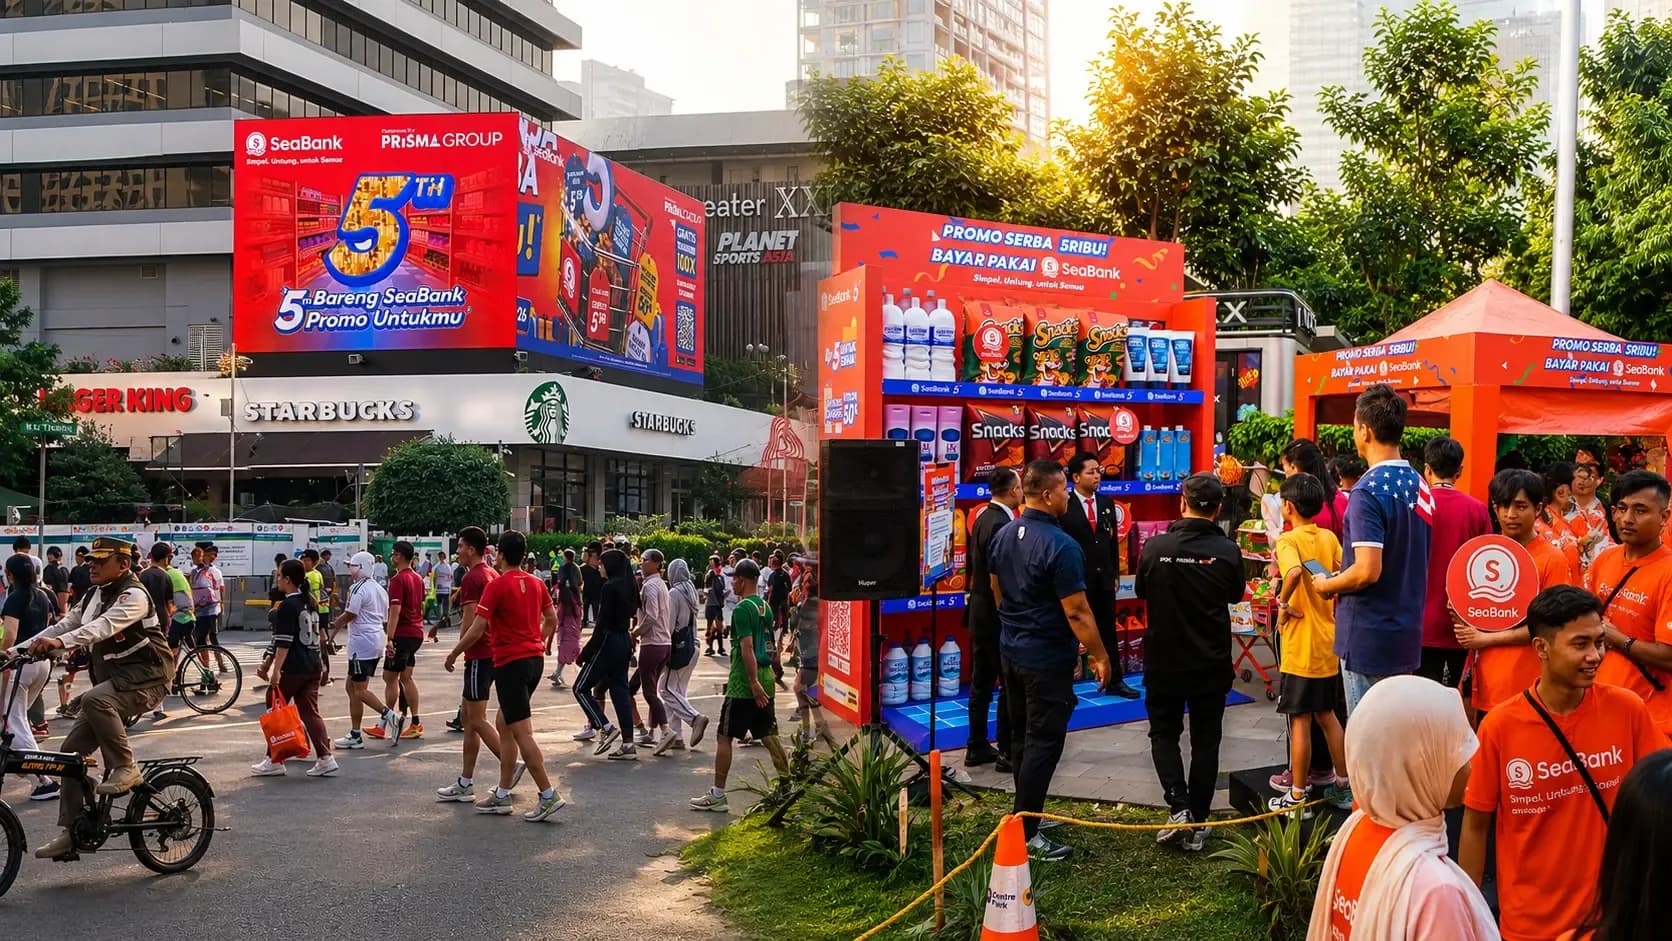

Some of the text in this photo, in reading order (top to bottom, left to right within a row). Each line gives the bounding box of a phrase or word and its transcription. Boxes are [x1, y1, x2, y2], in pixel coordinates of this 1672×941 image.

[270, 135, 343, 152] SeaBank
[442, 131, 503, 147] GROUP
[716, 229, 800, 252] PLANET
[942, 223, 1108, 256] PROMO SERBA 5RIBU!
[712, 251, 761, 265] SPORTS
[931, 247, 985, 268] BAYAR
[987, 254, 1037, 273] PAKAI
[1061, 262, 1121, 281] SeaBank
[314, 286, 464, 309] Bareng SeaBank
[305, 306, 463, 329] Promo Untukmu
[1034, 318, 1080, 347] Snacks
[1088, 323, 1129, 351] Snacks
[1552, 338, 1590, 352] PROMO
[1389, 360, 1422, 372] SeaBank
[1545, 357, 1665, 376] BAYAR PAKAI SeaBank
[126, 386, 193, 413] KING
[244, 400, 414, 422] STARBUCKS
[633, 410, 696, 436] STARBUCKS
[971, 422, 1025, 439] Snacks
[1029, 424, 1077, 441] Snacks
[1079, 422, 1111, 438] Snac
[1467, 606, 1519, 619] SeaBank
